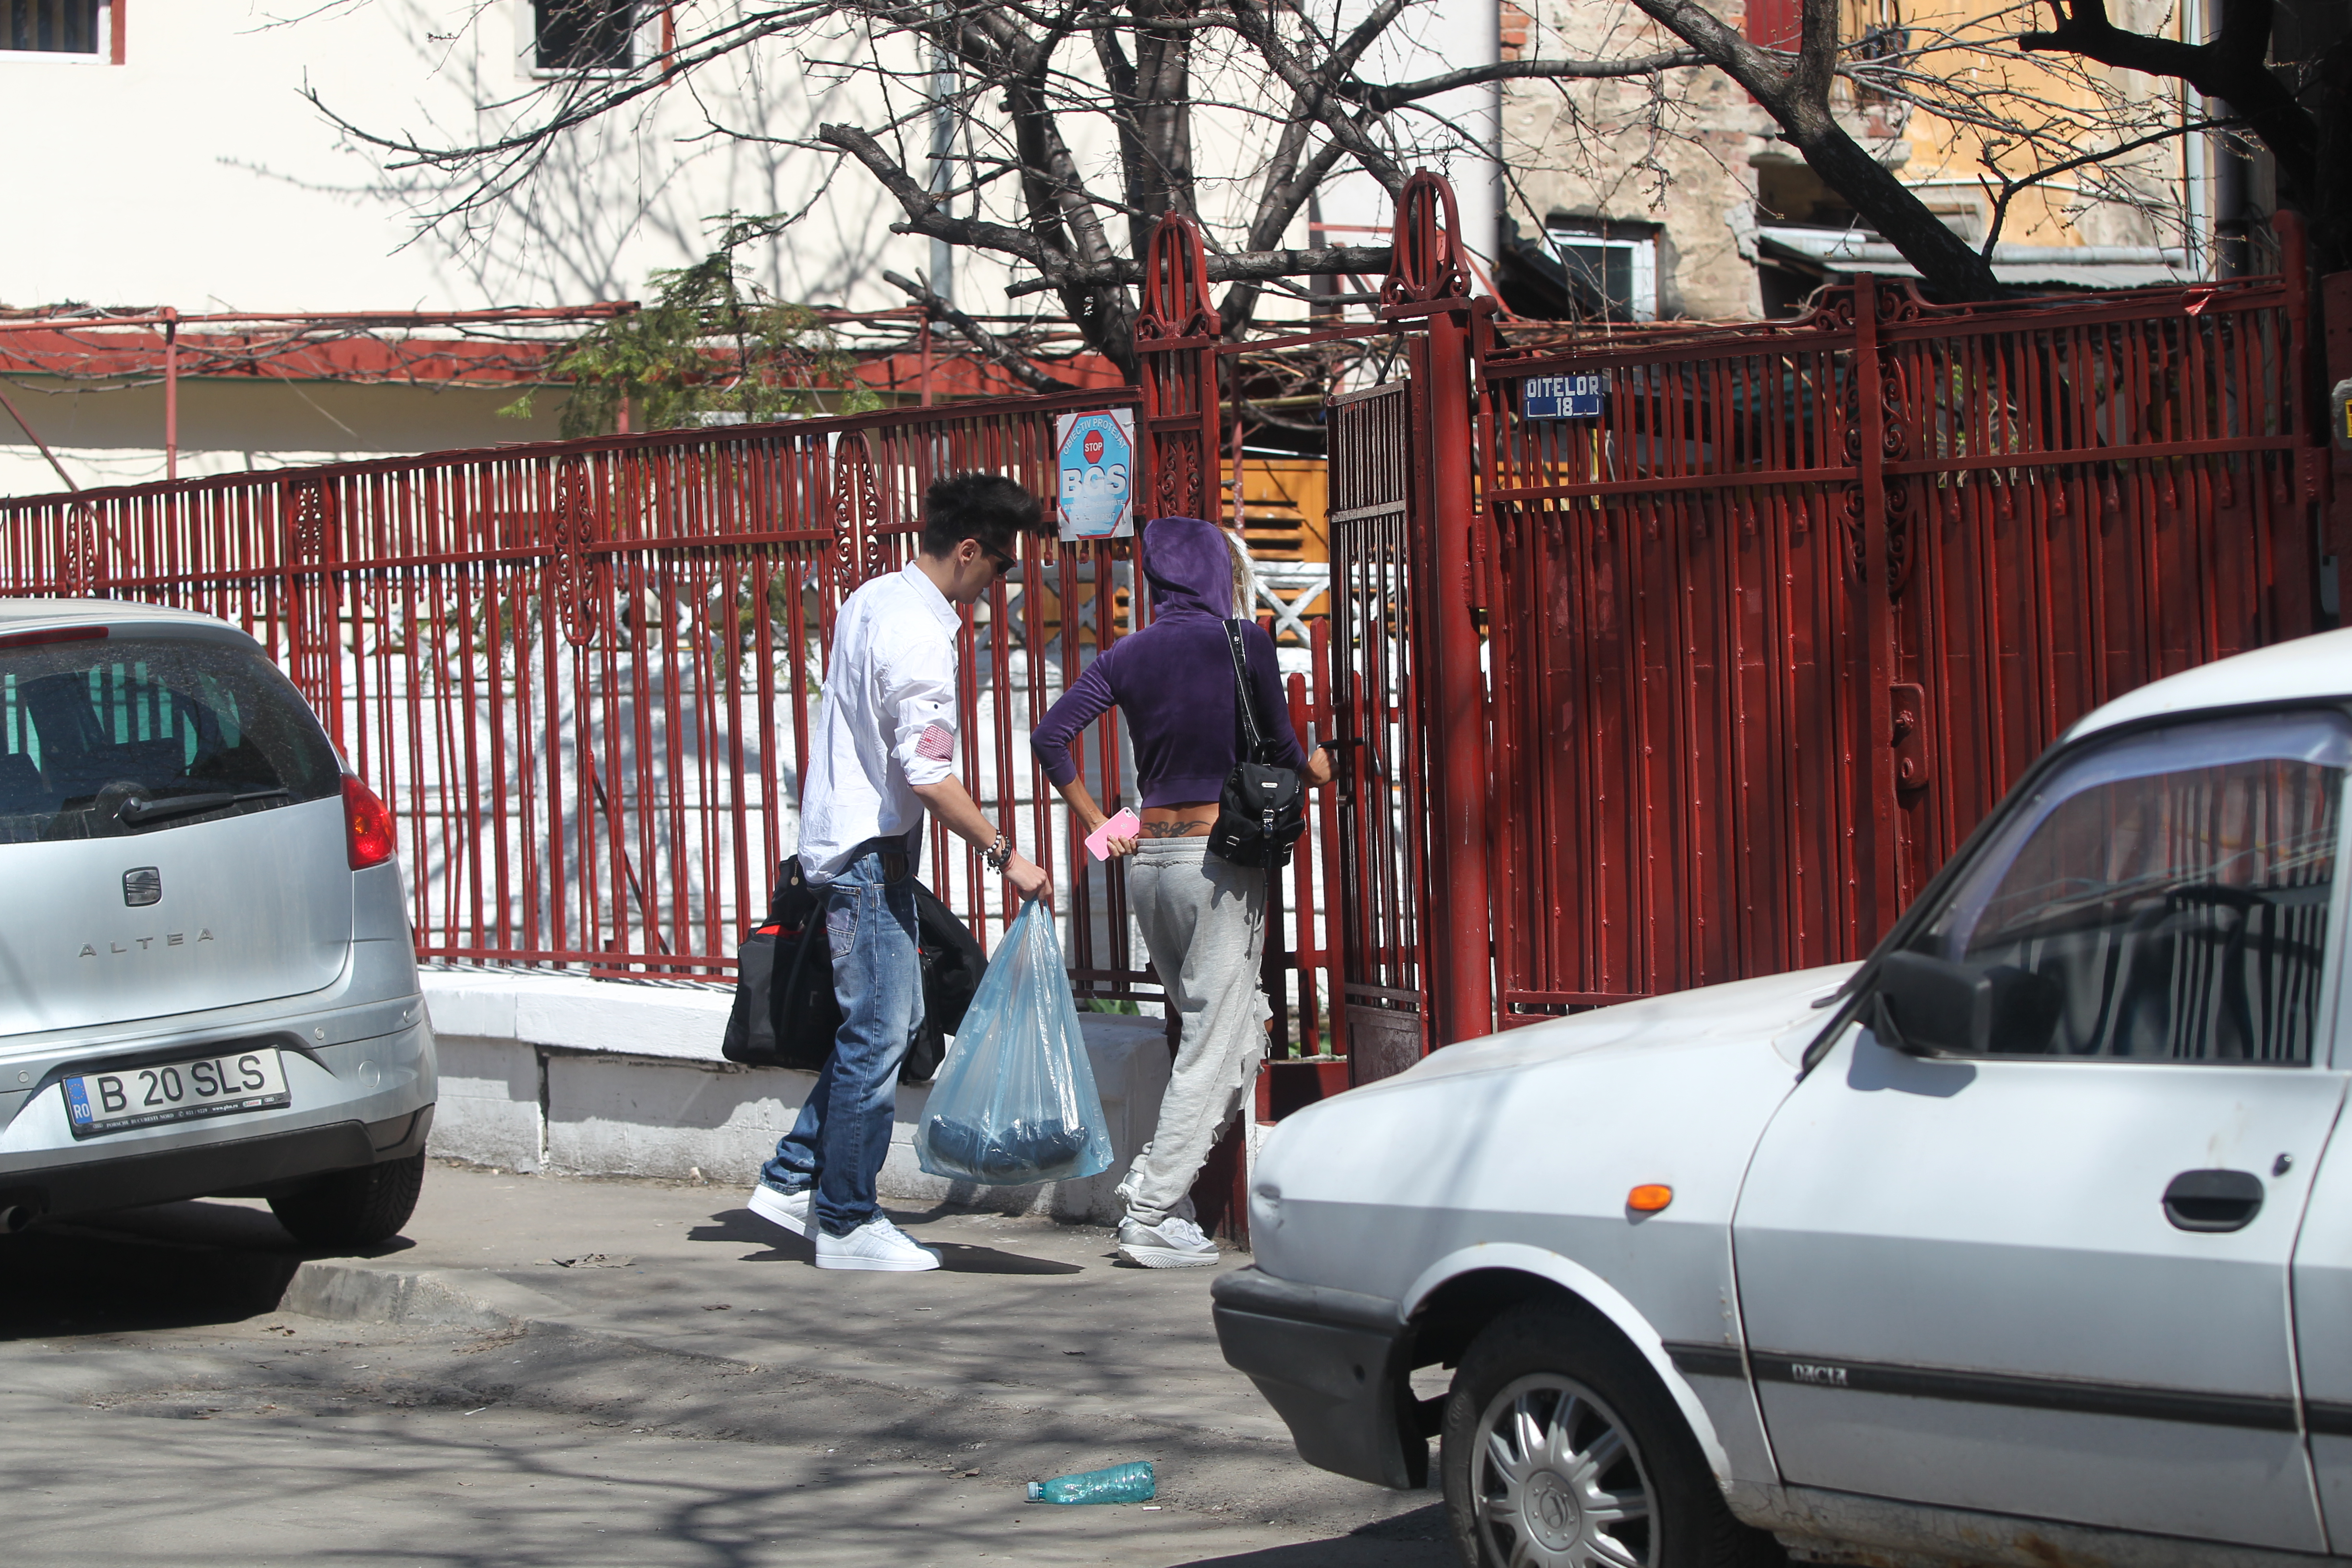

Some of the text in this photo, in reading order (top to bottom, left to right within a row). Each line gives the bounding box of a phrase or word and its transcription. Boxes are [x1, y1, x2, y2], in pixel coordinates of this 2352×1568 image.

[1527, 376, 1599, 398] OITELOR
[1556, 397, 1573, 416] 18
[1063, 418, 1127, 455] OBIECTIV PROTEJAT
[1085, 442, 1103, 452] STOP
[1062, 464, 1127, 499] BGS
[78, 927, 214, 957] ALTEA
[98, 1055, 265, 1113] B 20 SLS
[74, 1103, 90, 1119] RO
[107, 1120, 129, 1128] PORSCHE
[1791, 1363, 1849, 1386] DACIA
